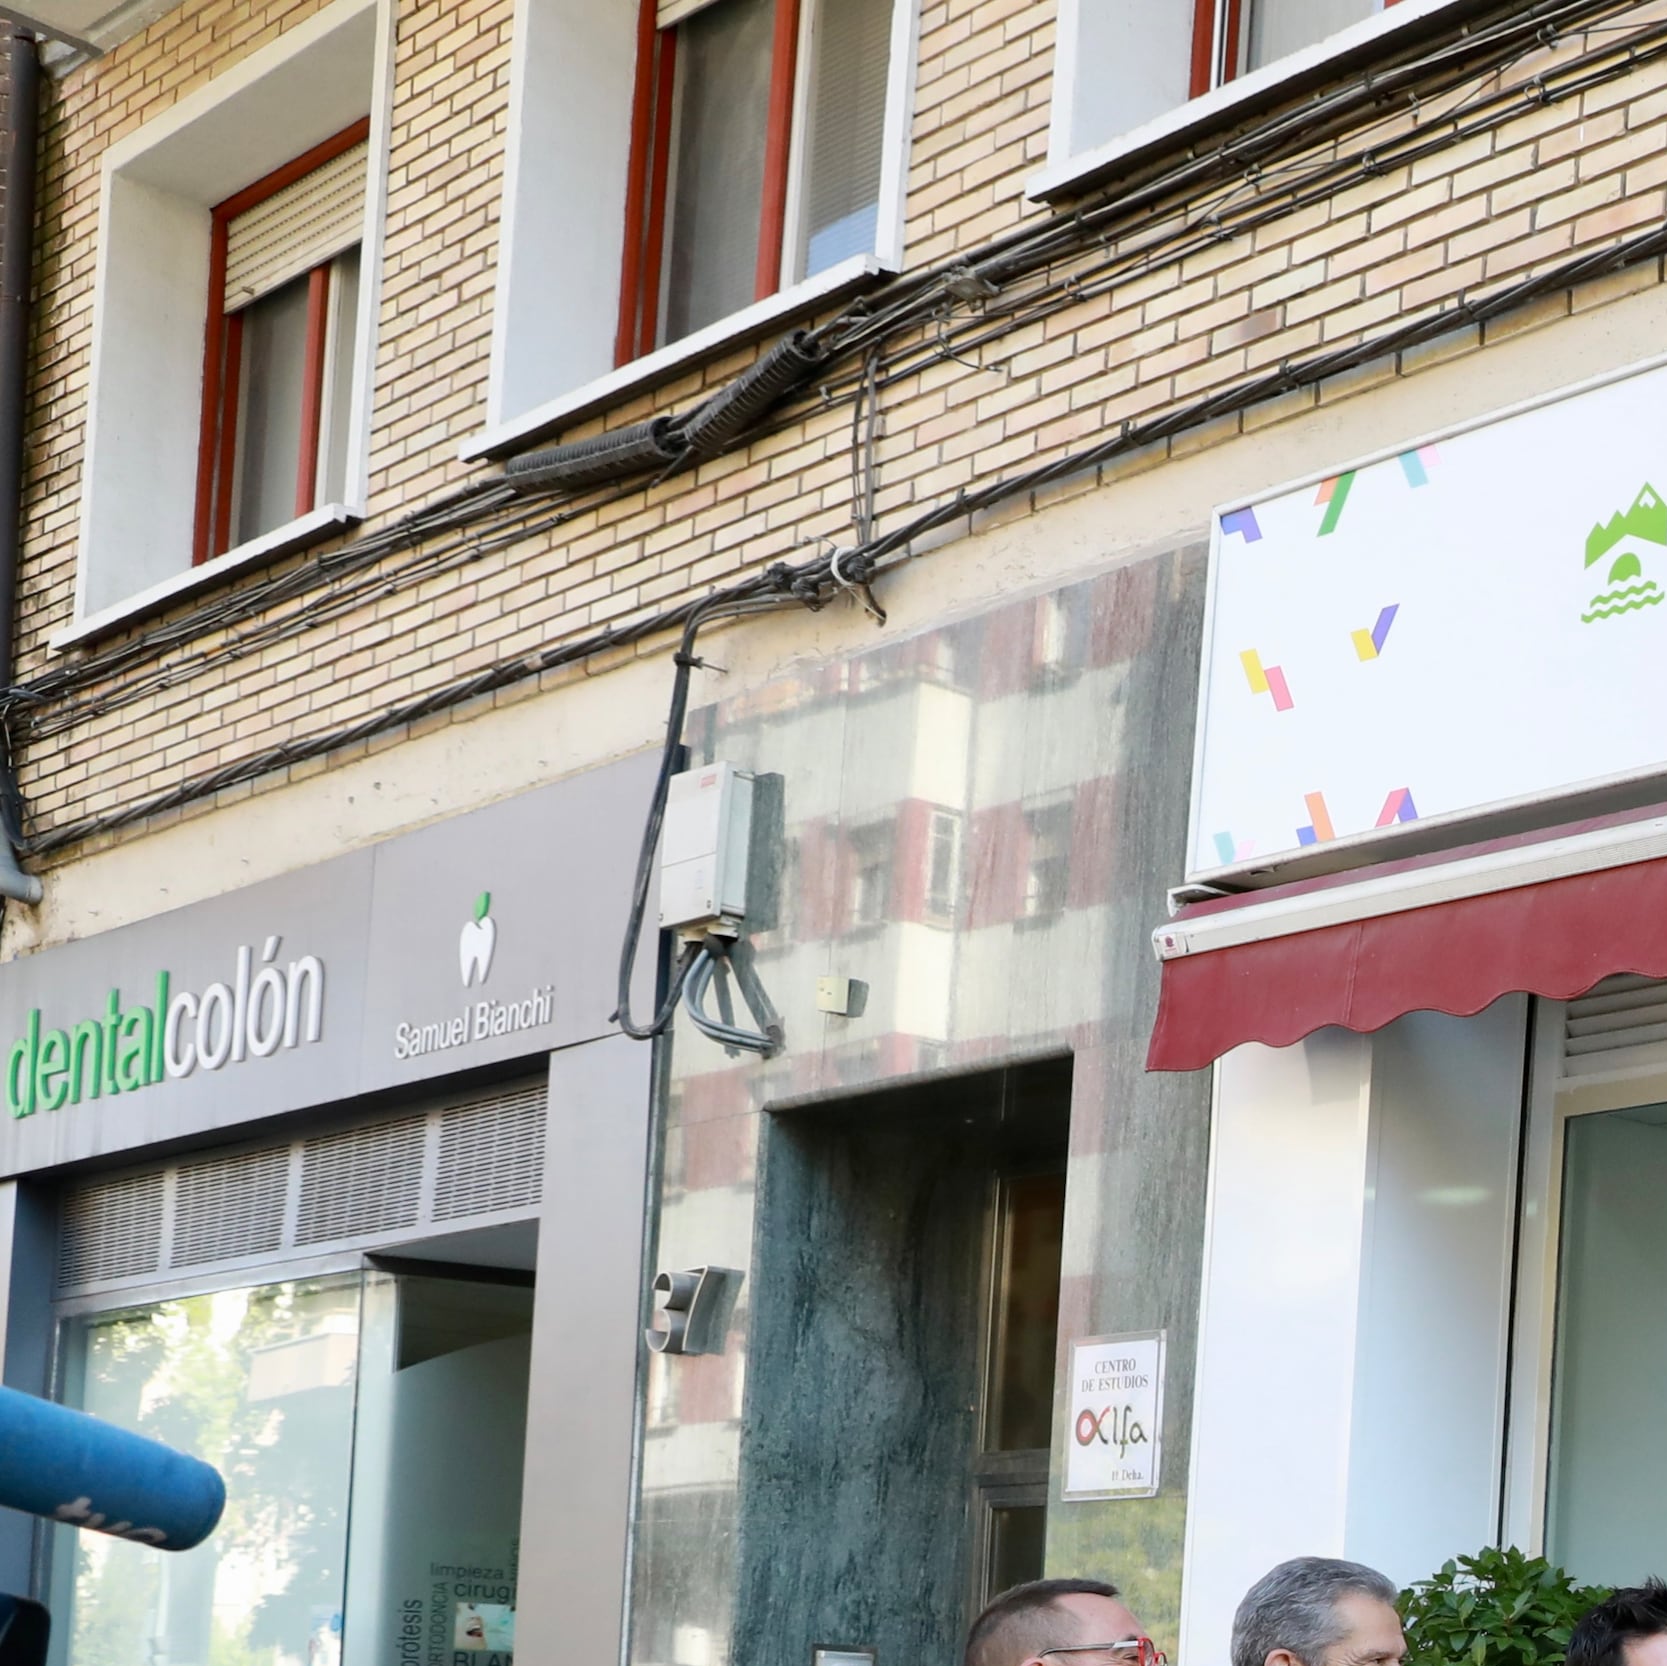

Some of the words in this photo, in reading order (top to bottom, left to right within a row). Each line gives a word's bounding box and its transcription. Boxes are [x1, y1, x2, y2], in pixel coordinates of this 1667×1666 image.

[7, 936, 325, 1119] dentalcolón
[395, 1005, 470, 1061] Samuel
[475, 985, 555, 1036] Bianchi
[645, 1265, 722, 1354] 37
[1081, 1379, 1095, 1392] DE
[1098, 1374, 1149, 1391] ESTUDIOS
[1095, 1358, 1136, 1374] CENTRO
[430, 1562, 504, 1580] limpieza
